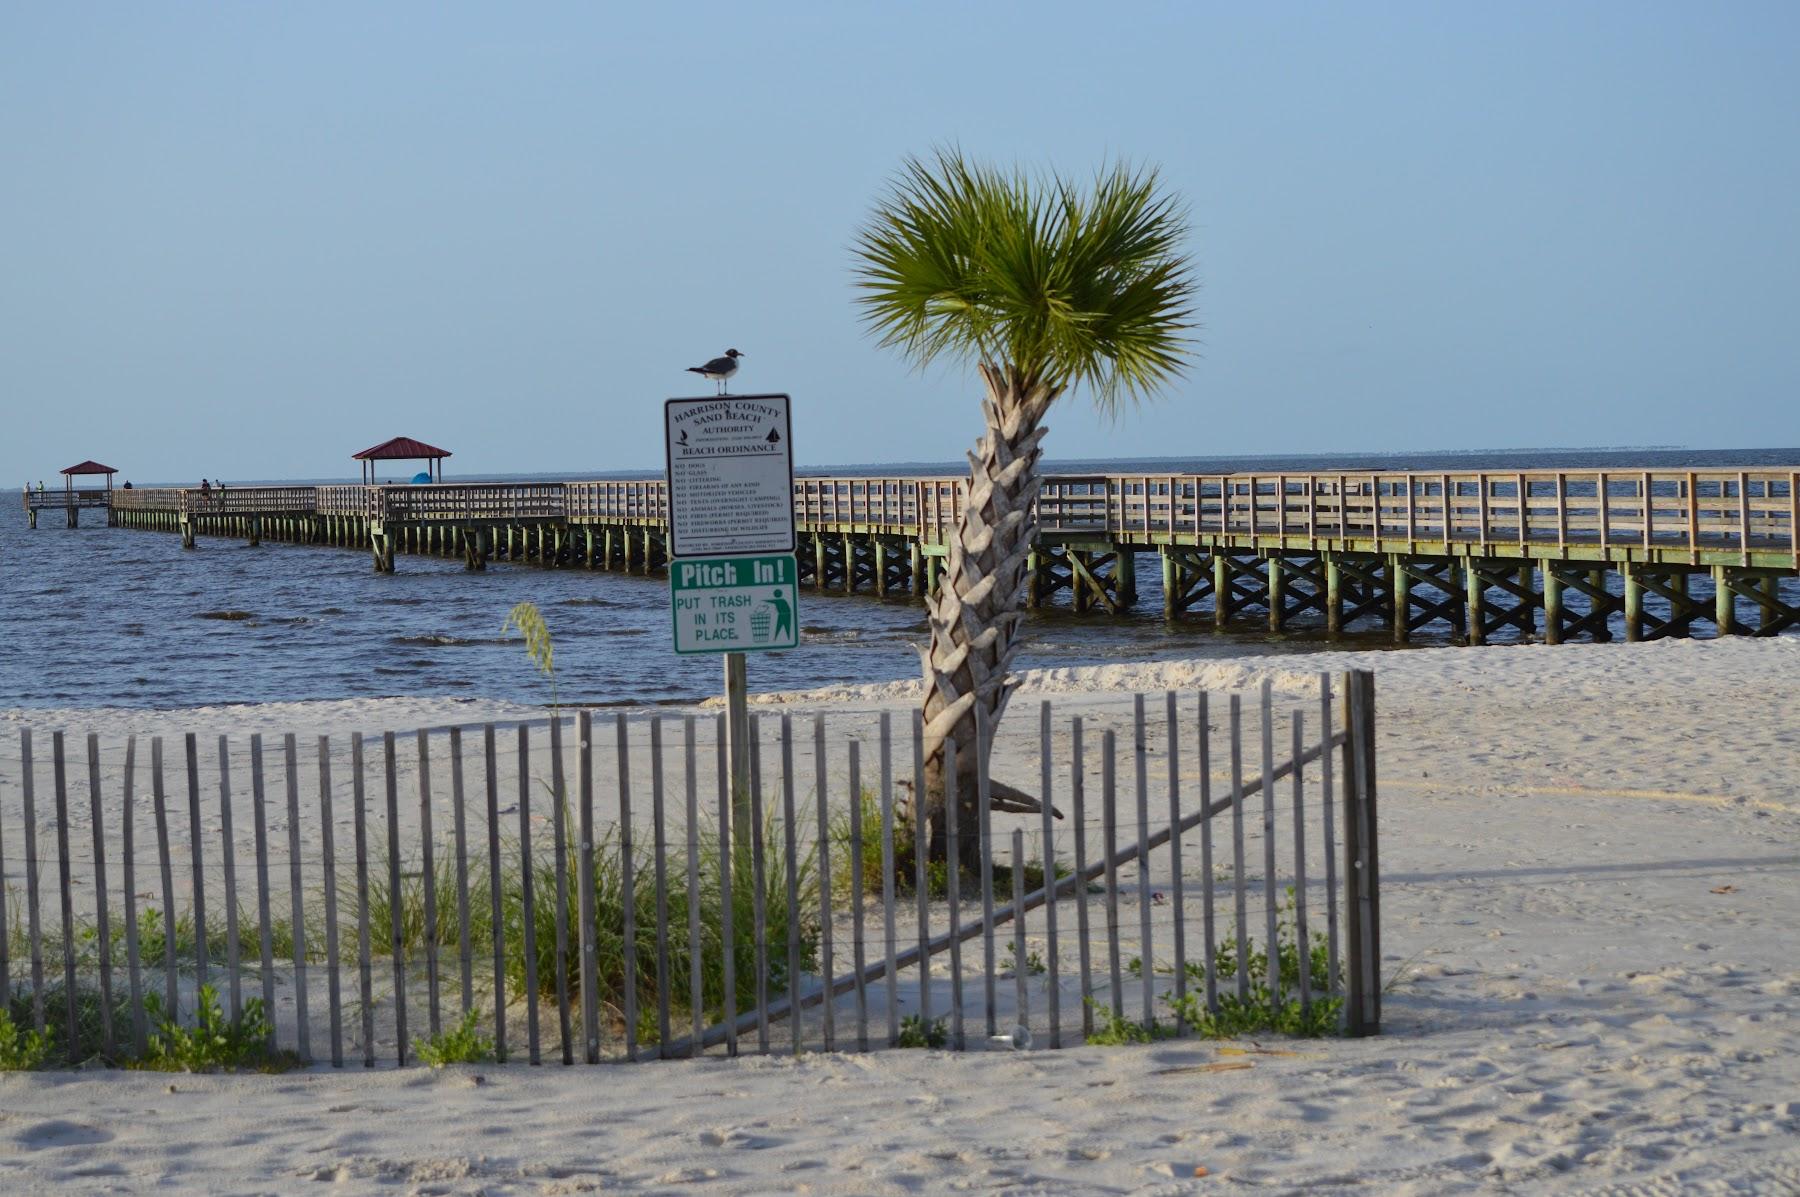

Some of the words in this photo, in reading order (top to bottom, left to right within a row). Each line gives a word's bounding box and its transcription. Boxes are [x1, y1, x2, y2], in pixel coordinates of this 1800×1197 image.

[674, 402, 730, 423] HARRISON
[736, 403, 781, 417] COUNTY
[694, 413, 722, 425] SAND
[726, 412, 761, 423] BEACH
[703, 425, 754, 434] AUTHORITY
[682, 447, 715, 455] BEACH
[718, 444, 776, 454] ORDINANCE
[681, 562, 737, 587] Pitch
[754, 560, 784, 583] In!
[677, 597, 700, 609] PUT
[710, 595, 751, 608] TRASH
[695, 614, 706, 624] IN
[716, 613, 735, 624] ITS
